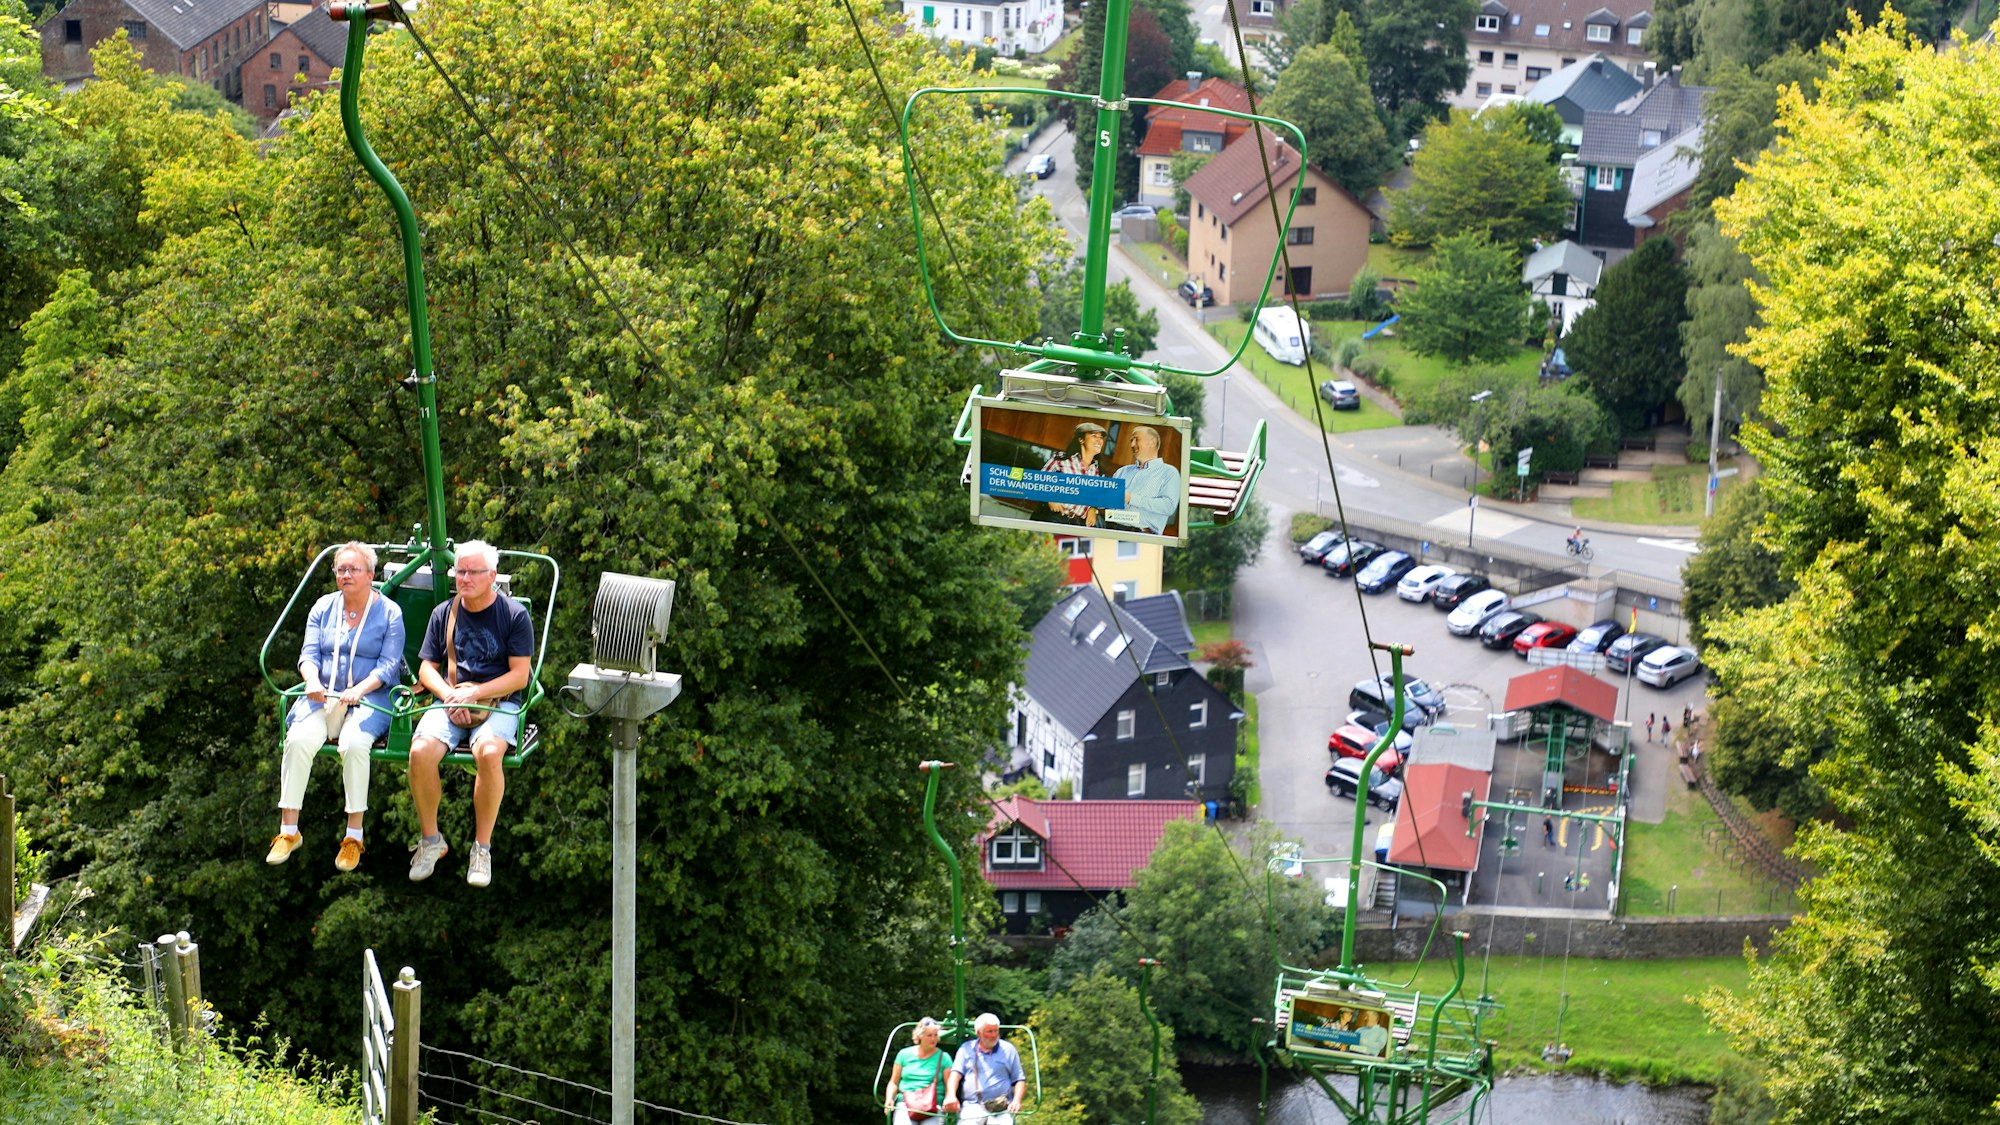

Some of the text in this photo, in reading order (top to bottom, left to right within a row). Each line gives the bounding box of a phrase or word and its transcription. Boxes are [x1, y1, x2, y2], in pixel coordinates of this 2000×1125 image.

[1100, 130, 1111, 147] 5
[420, 406, 430, 419] 11
[989, 477, 1006, 487] DER
[1007, 480, 1080, 496] WANDEREXPRESS
[1033, 473, 1058, 483] BURG
[1066, 476, 1119, 489] MÜNGSTEN:
